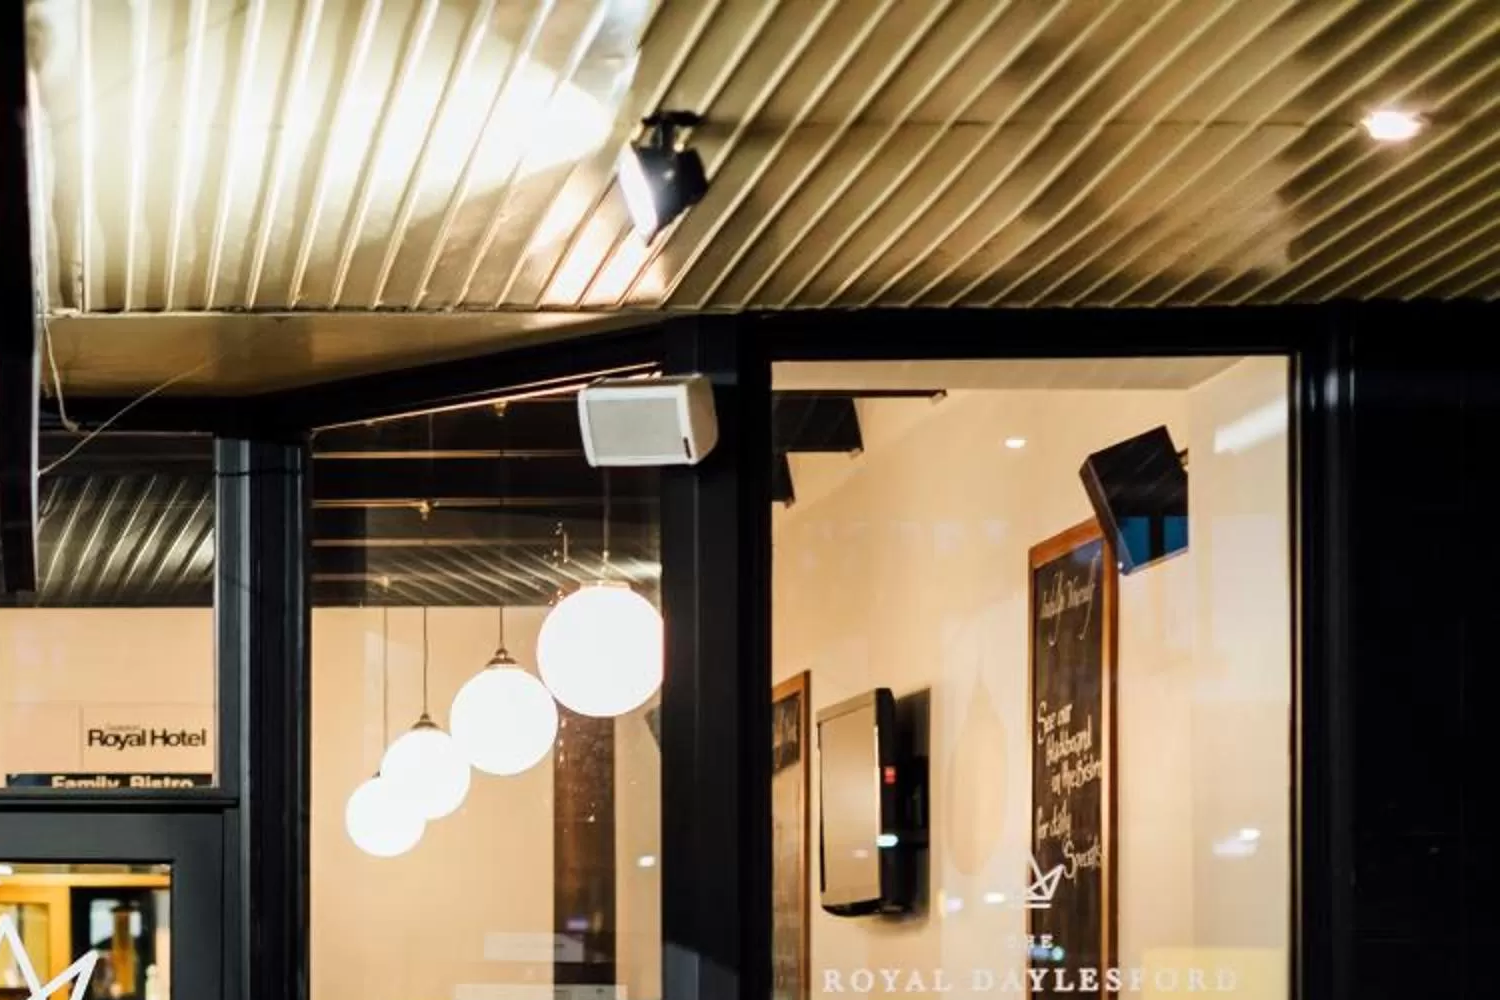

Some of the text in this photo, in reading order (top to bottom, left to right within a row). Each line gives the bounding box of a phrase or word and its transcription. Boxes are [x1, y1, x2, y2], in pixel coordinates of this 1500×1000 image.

[87, 727, 207, 749] Royal Hotel
[51, 775, 196, 788] Family Bistro
[822, 968, 1238, 993] ROYAL DAYLESFORD
